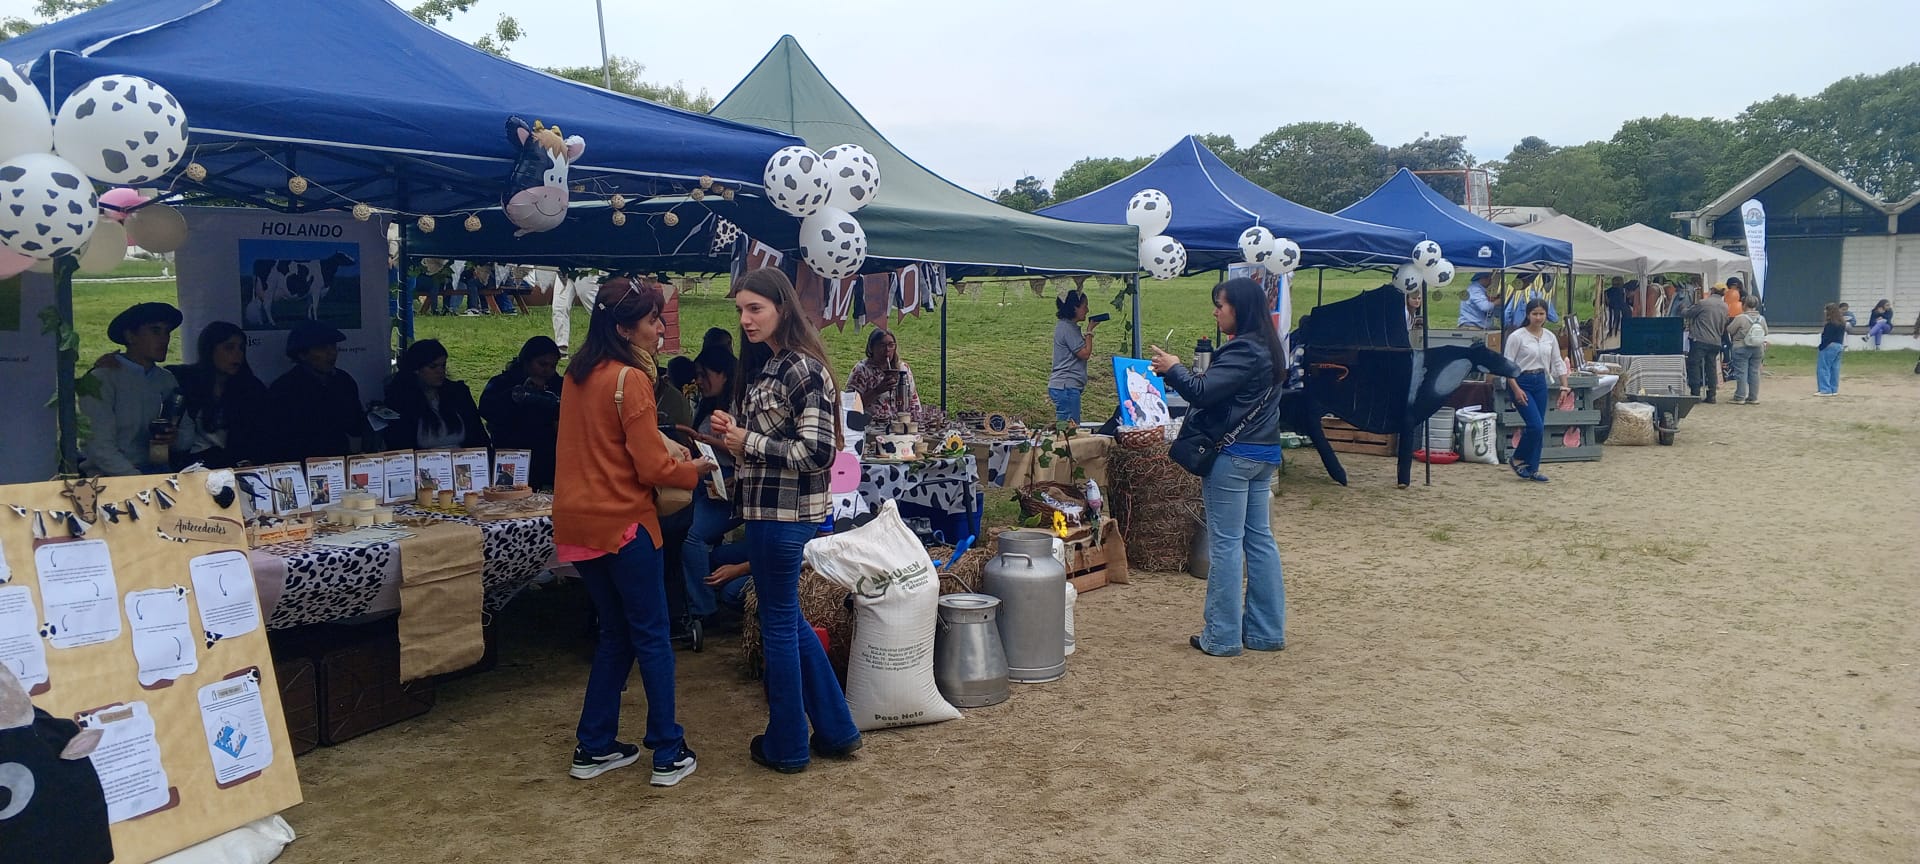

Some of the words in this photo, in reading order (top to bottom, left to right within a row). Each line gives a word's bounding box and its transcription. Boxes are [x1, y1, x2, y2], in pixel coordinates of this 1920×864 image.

[261, 222, 343, 238] HOLANDO
[174, 519, 226, 535] Antecedentes
[874, 713, 899, 721] Peso
[901, 711, 924, 720] Neto
